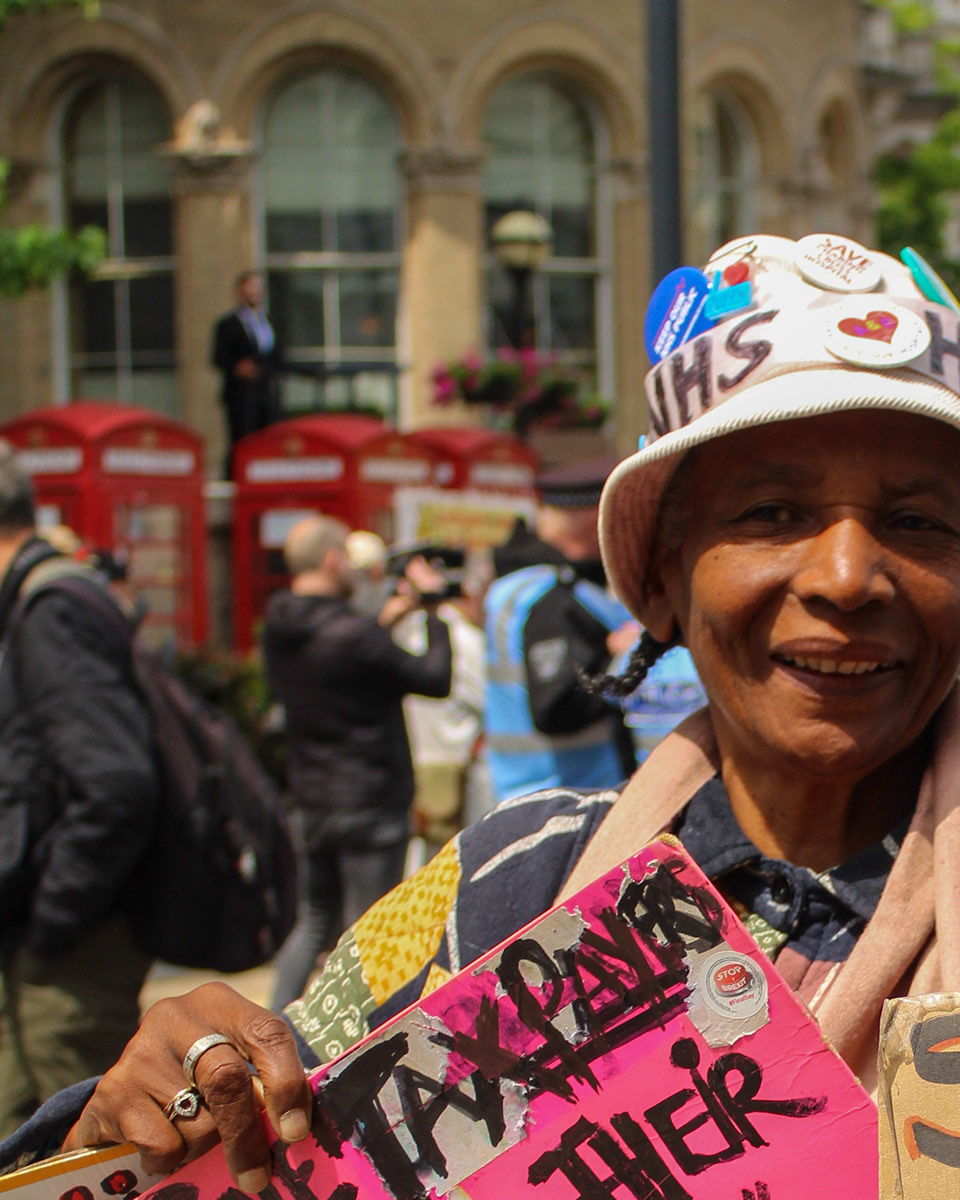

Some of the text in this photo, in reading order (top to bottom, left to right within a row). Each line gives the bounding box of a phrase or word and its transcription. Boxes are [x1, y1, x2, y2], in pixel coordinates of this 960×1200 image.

[717, 965, 743, 981] STOP
[721, 977, 747, 992] BREXIT
[728, 993, 755, 1007] #FinalSay
